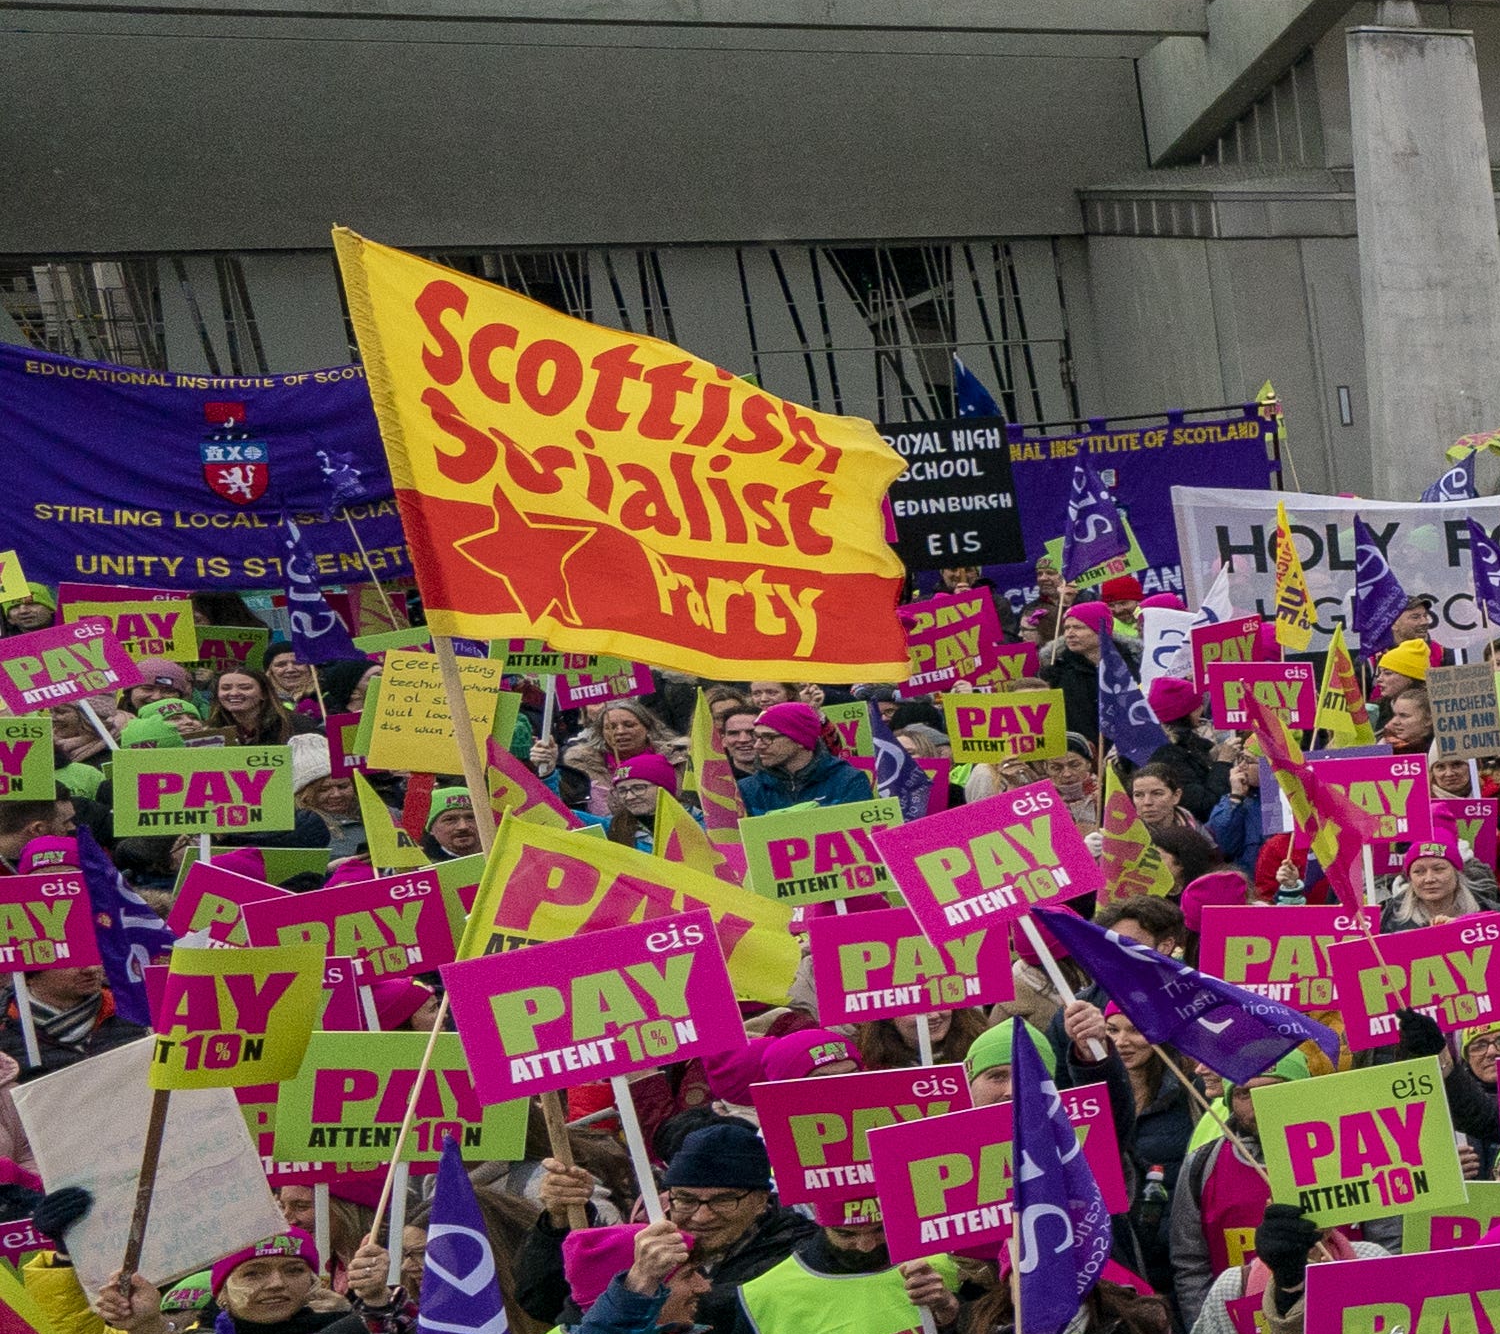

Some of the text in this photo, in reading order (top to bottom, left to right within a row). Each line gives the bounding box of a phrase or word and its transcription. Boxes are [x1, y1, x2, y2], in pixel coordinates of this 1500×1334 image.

[26, 360, 172, 387] EDUCATIONAL
[176, 375, 275, 389] INSTITUTE
[283, 373, 309, 386] OF
[415, 278, 844, 474] Scottish
[883, 428, 1000, 457] ROYAL HIGH
[1144, 430, 1168, 449] OF
[1172, 421, 1260, 446] SCOTLAND
[420, 386, 835, 556] Socialist
[896, 457, 984, 481] SCHOOL
[34, 503, 162, 527] STIRLING
[174, 511, 270, 529] LOCAL
[895, 493, 1013, 517] EDINBURGH
[927, 531, 982, 555] EIS
[76, 554, 183, 577] UNITY
[196, 557, 232, 577] IS
[653, 550, 823, 662] Party
[1434, 693, 1496, 711] TEACHERS
[1437, 714, 1466, 731] CAN
[246, 752, 285, 768] eis
[138, 771, 274, 809] PAY
[1012, 788, 1054, 818] eis
[914, 814, 1062, 906] PAY
